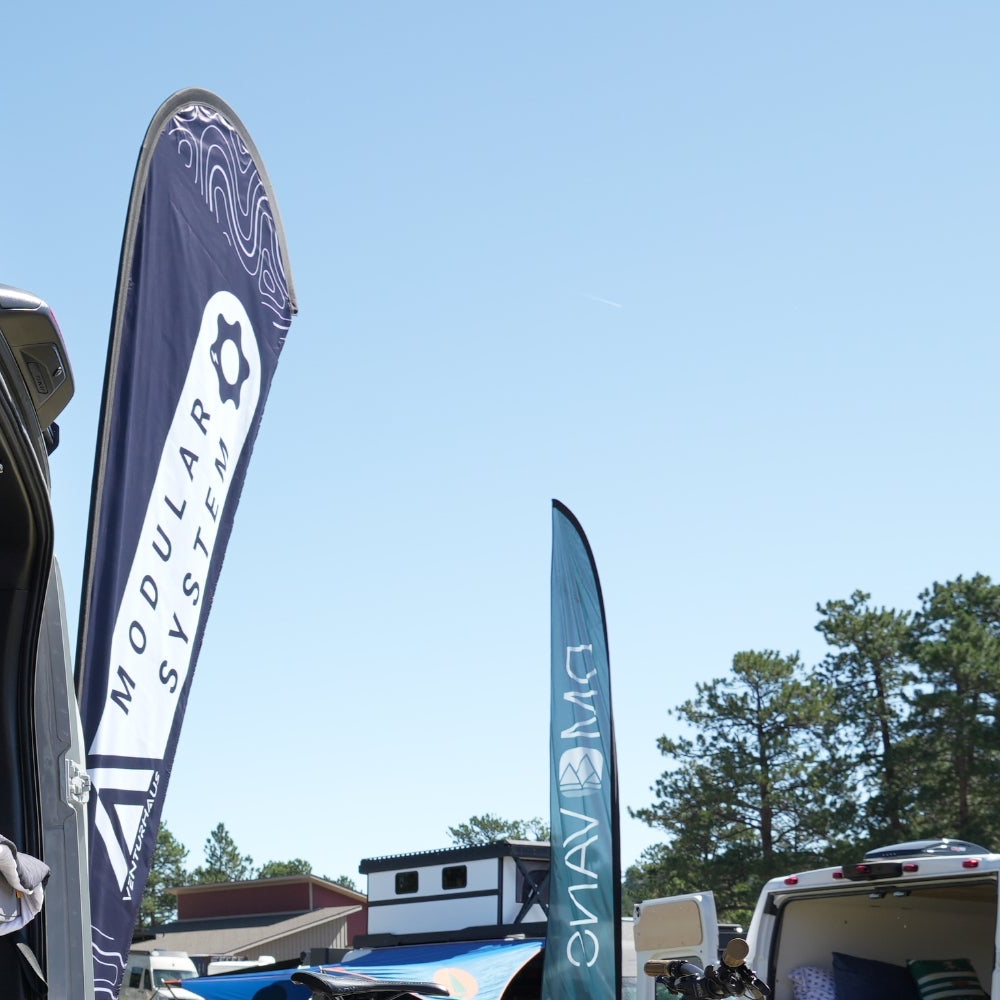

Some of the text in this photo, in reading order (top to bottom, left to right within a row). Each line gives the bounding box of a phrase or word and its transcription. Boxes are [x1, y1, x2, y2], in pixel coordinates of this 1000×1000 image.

[110, 398, 212, 716] MODULAR
[158, 436, 232, 694] SYSTEM
[122, 770, 160, 901] VENTURHAUS
